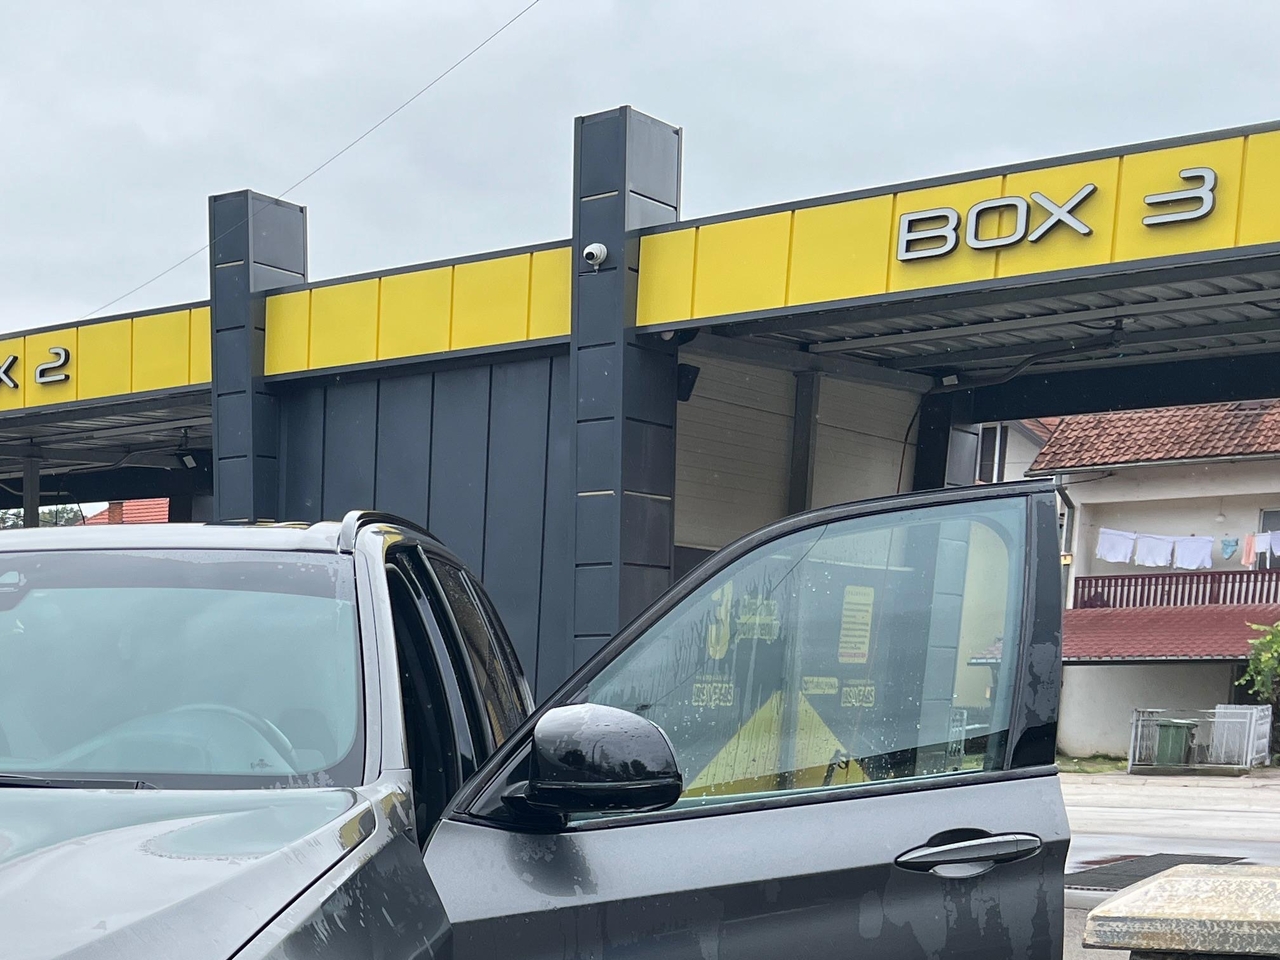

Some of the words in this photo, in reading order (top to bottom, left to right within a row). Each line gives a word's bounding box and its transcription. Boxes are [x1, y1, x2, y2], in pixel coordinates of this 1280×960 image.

[897, 183, 1098, 262] BOX
[1141, 166, 1218, 227] 3
[35, 346, 71, 385] 2
